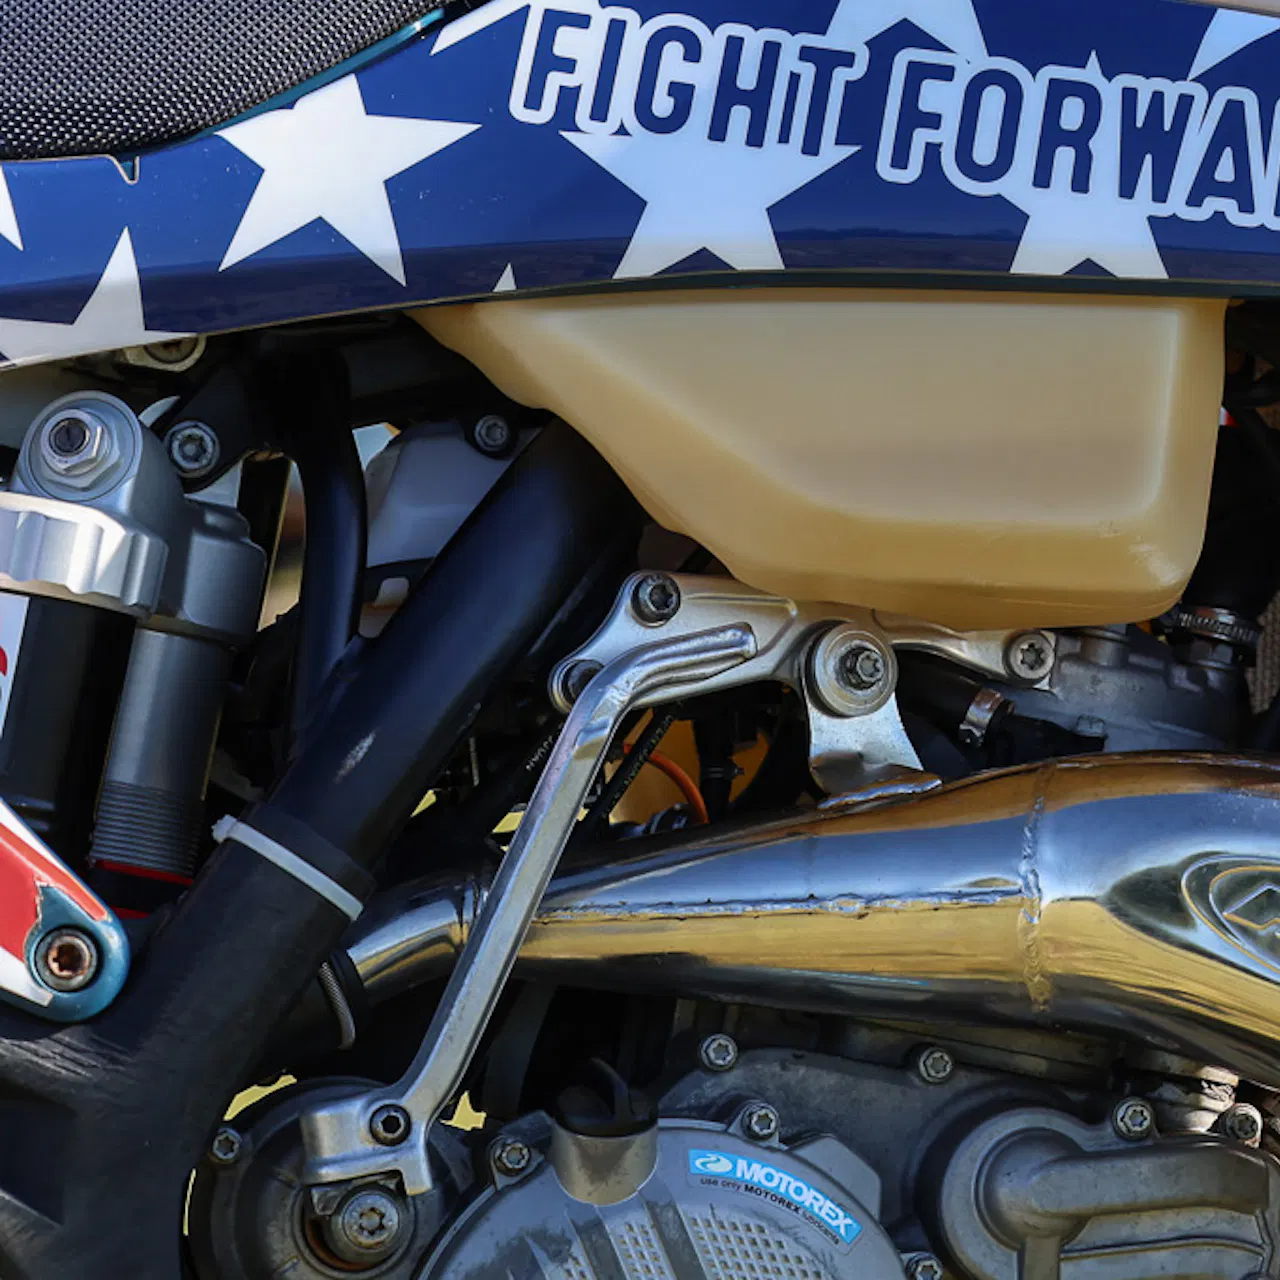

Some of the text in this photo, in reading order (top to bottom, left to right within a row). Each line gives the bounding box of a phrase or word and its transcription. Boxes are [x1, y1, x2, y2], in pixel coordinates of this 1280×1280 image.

[517, 7, 862, 158] FIGHT
[700, 1177, 719, 1188] use
[721, 1178, 742, 1193] only
[744, 1183, 802, 1216] MOTOREX
[736, 1158, 854, 1237] MOTOREX
